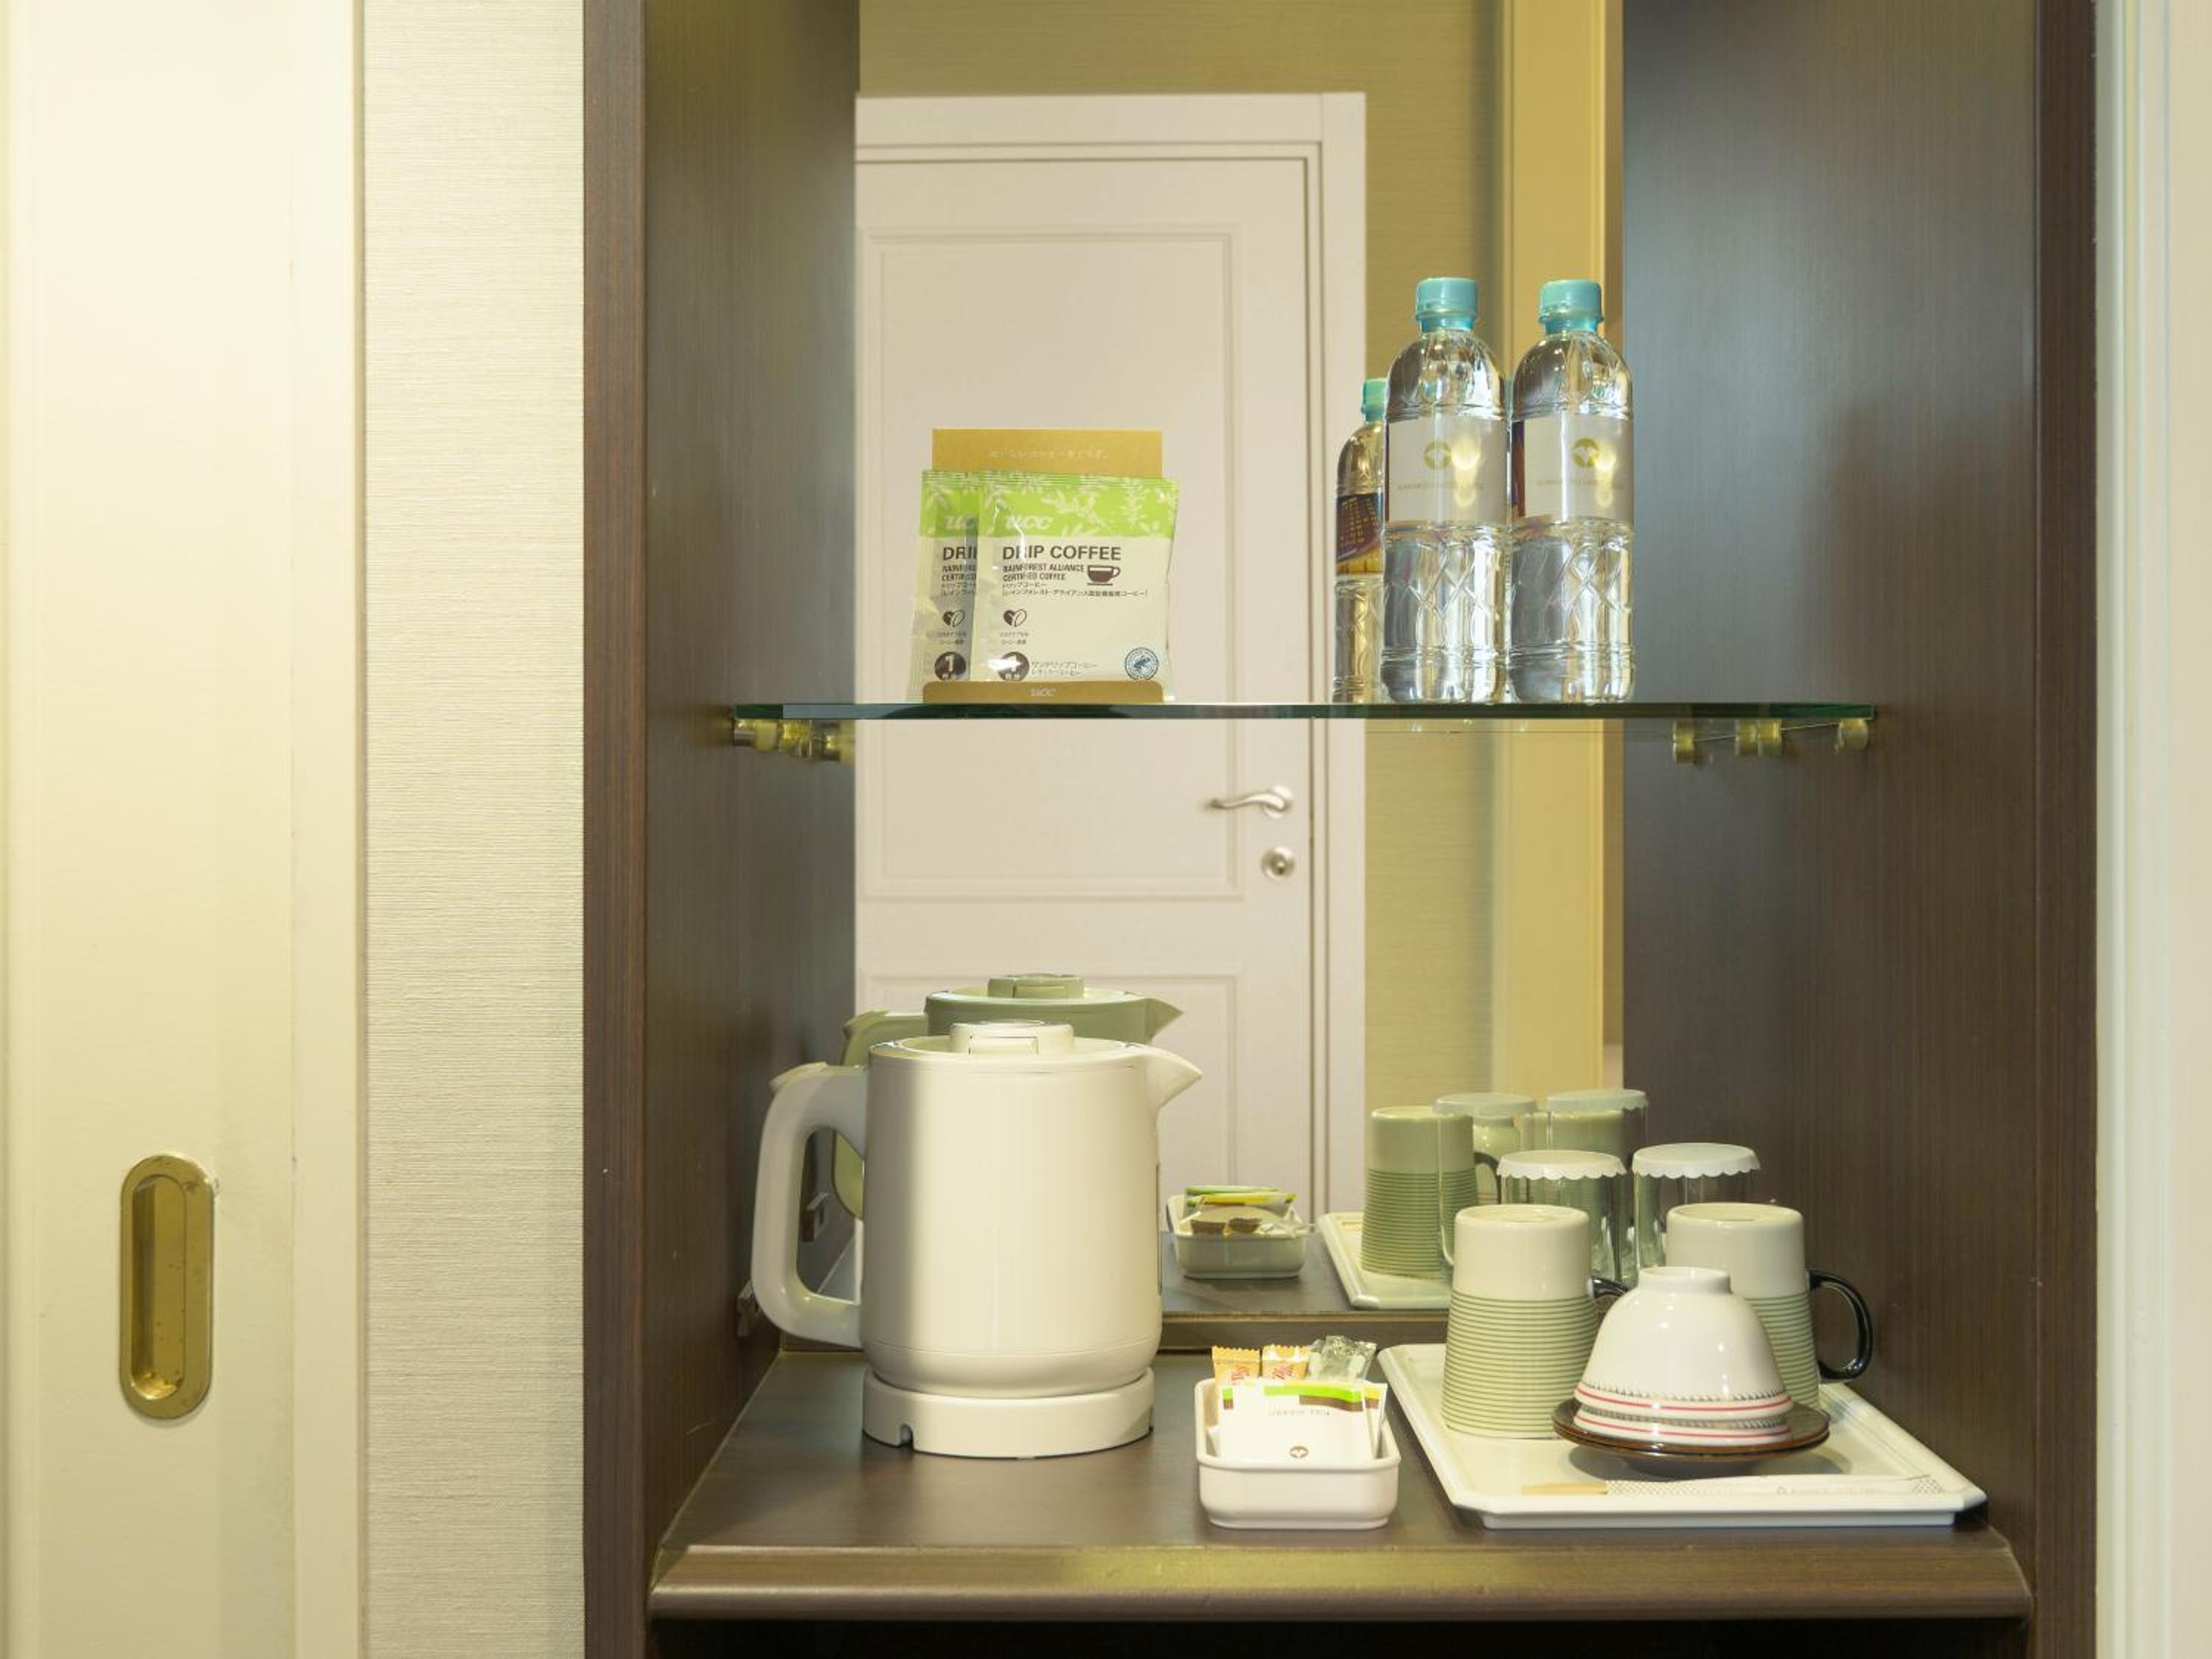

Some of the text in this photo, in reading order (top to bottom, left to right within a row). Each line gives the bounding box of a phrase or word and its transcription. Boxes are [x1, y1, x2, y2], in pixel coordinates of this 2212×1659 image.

[942, 546, 978, 560] DRI
[1050, 546, 1121, 561] COFFEE
[942, 565, 977, 573] RAINFORE
[1003, 563, 1085, 573] RAINFOREST ALLIANCE
[945, 655, 955, 672] 1
